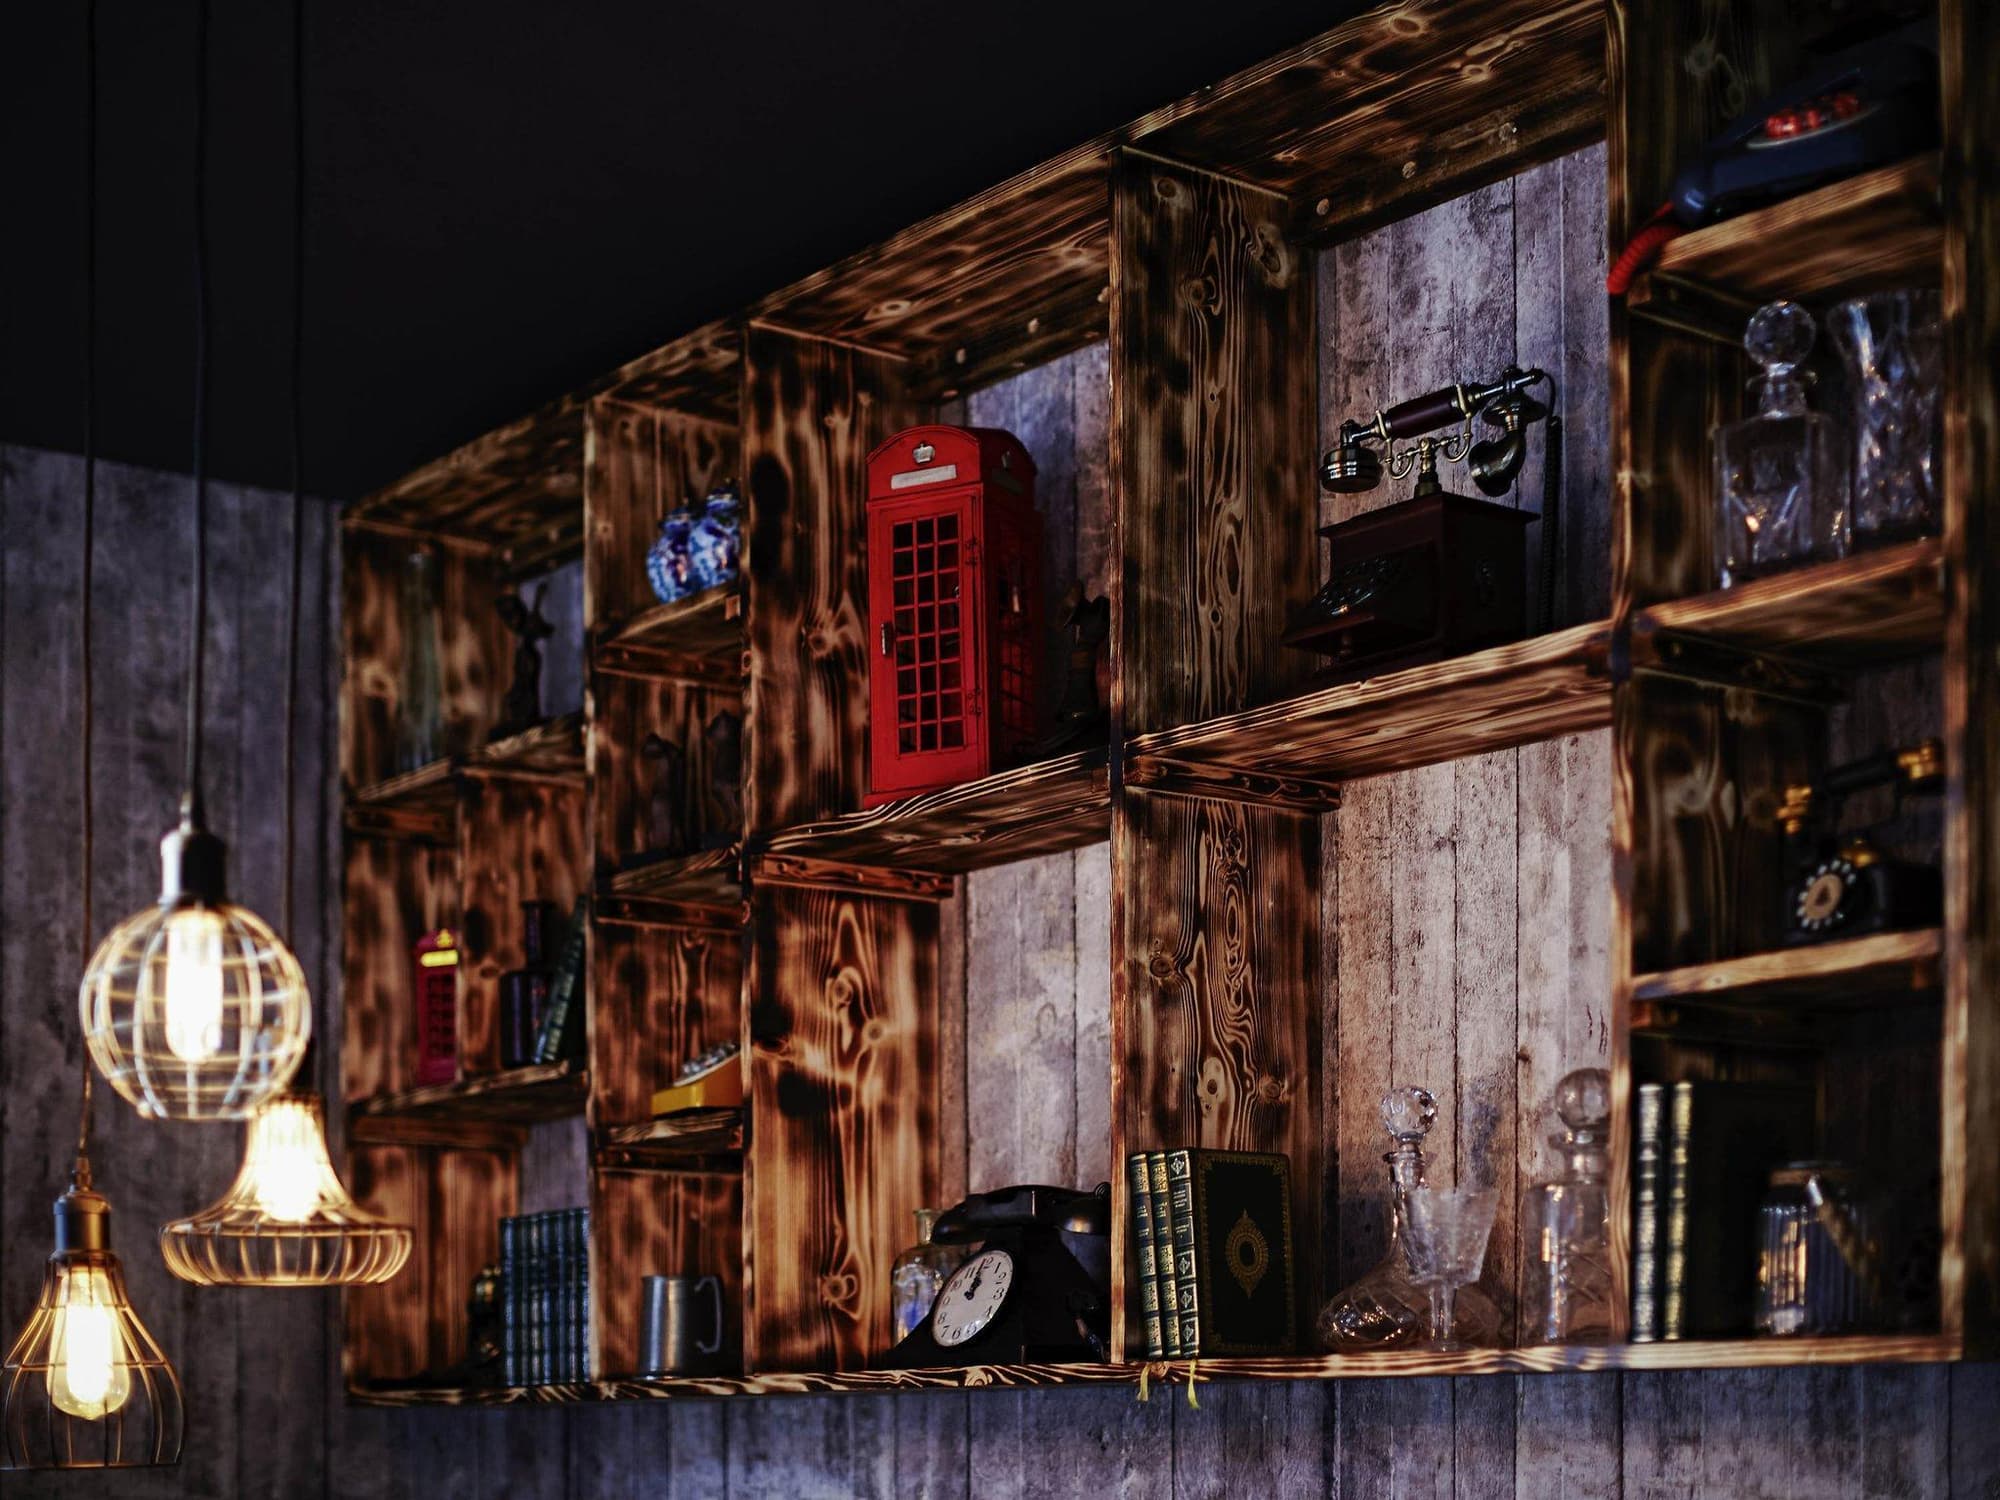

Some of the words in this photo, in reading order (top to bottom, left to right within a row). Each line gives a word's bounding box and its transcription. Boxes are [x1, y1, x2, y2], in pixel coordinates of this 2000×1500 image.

[964, 1267, 976, 1279] 11
[994, 1262, 1002, 1274] 1
[995, 1272, 1007, 1285] 2
[993, 1288, 1005, 1300] 3
[937, 1312, 947, 1324] 8
[941, 1325, 950, 1338] 7
[951, 1327, 962, 1340] 6
